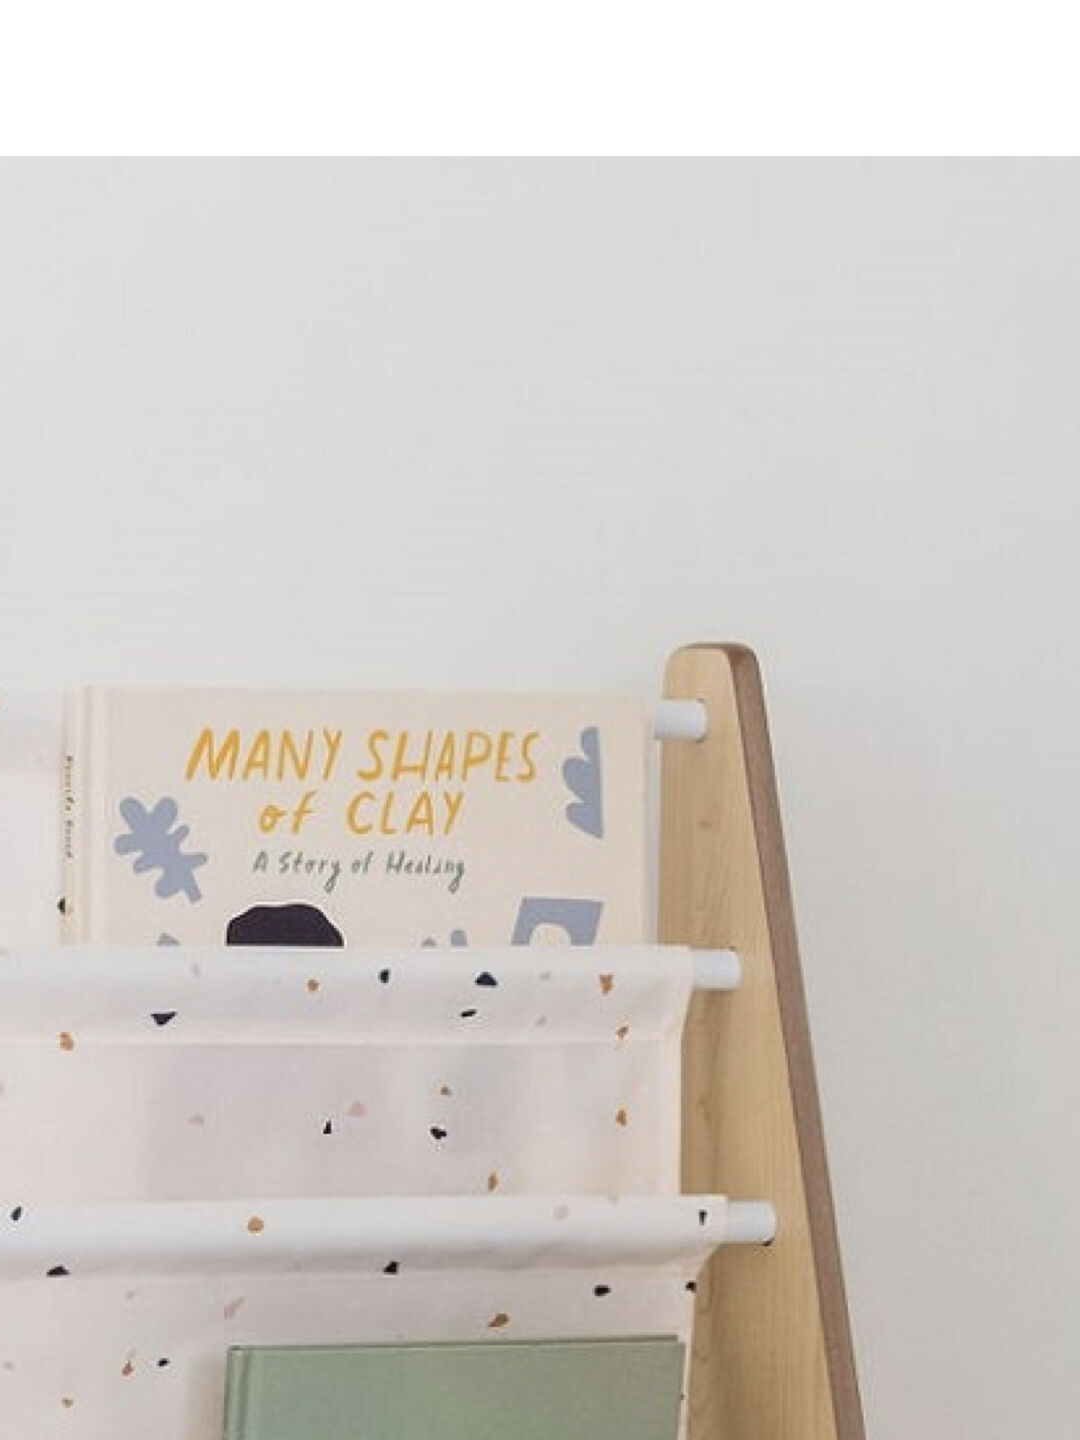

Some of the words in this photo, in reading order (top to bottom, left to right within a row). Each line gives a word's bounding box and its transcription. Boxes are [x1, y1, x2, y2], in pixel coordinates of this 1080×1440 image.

[185, 727, 343, 783] MANY
[356, 727, 541, 784] SHAPES
[257, 790, 315, 835] of
[344, 789, 466, 837] CLAY
[252, 850, 270, 874] A
[277, 850, 342, 895] Story
[350, 850, 375, 875] of
[385, 850, 466, 896] Healing
